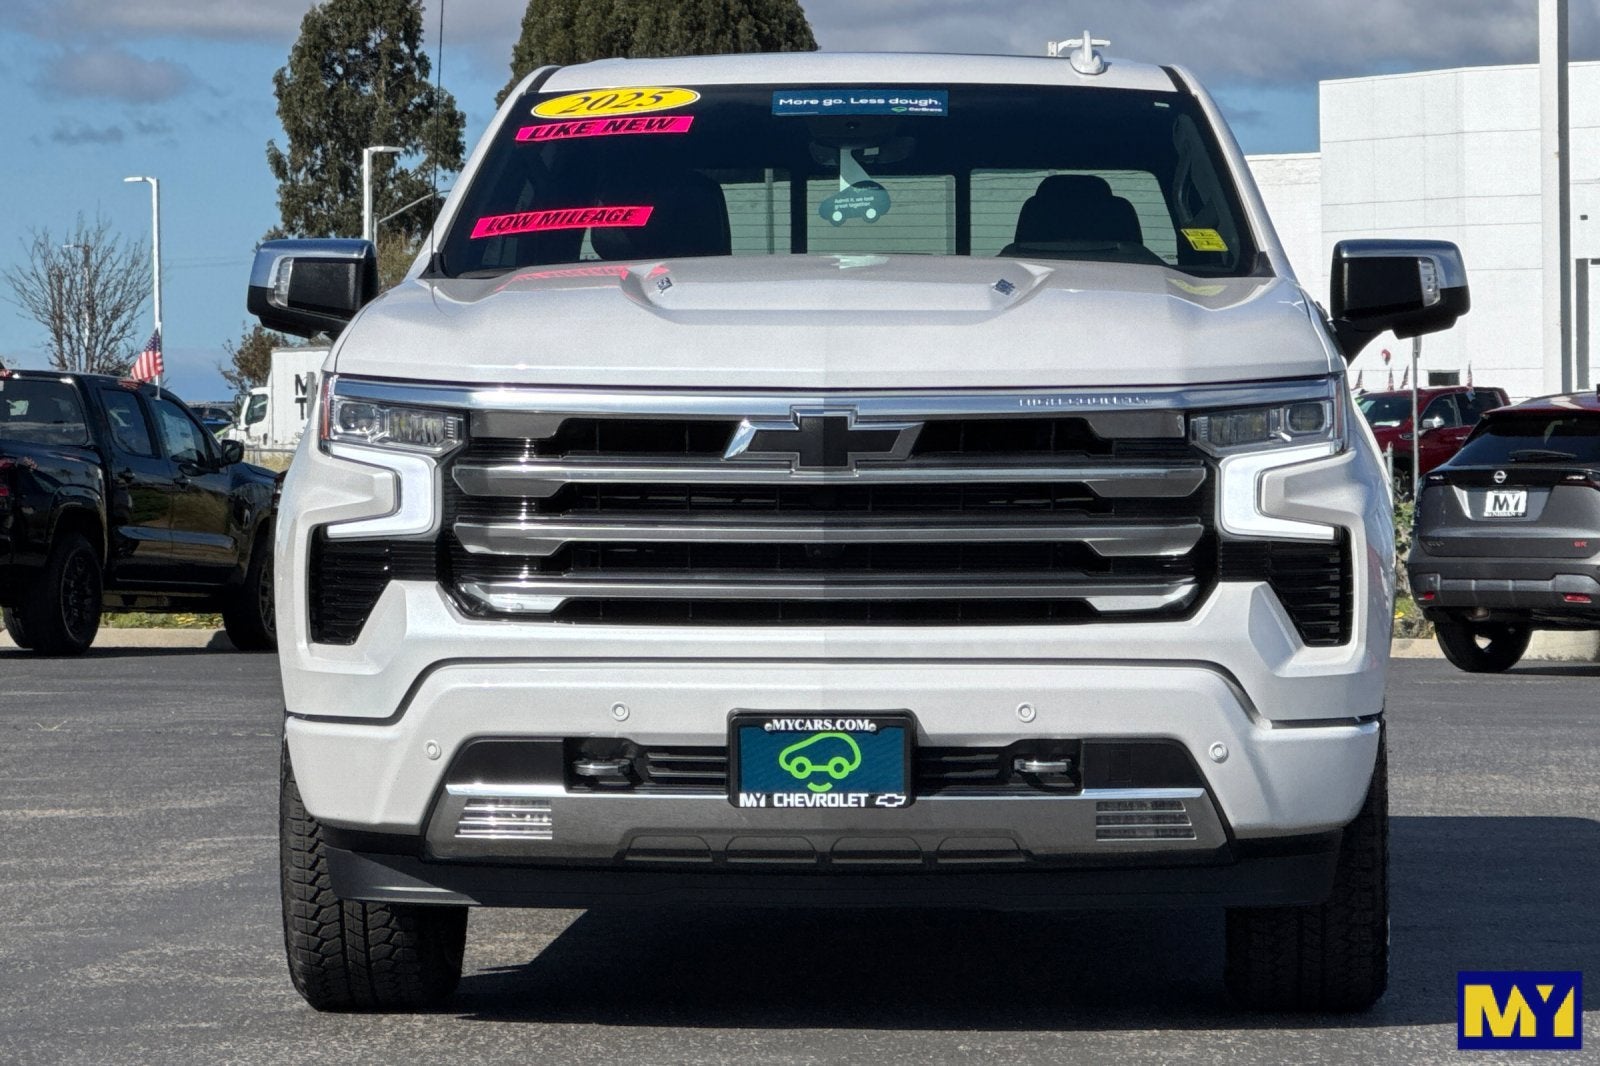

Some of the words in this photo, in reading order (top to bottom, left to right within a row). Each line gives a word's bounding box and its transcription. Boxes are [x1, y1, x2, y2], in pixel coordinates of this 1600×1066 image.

[555, 90, 674, 115] 2025
[778, 98, 819, 106] More
[822, 97, 847, 106] go.
[850, 97, 885, 105] Less
[888, 97, 942, 106] dough.
[526, 121, 594, 140] LIKE
[602, 117, 676, 133] NEW
[485, 212, 537, 232] LOW
[534, 208, 637, 227] MILEAGE
[1492, 494, 1520, 511] MY
[772, 719, 870, 731] MYCARS.COM
[739, 793, 766, 807] MY
[773, 793, 869, 807] CHEVROLET
